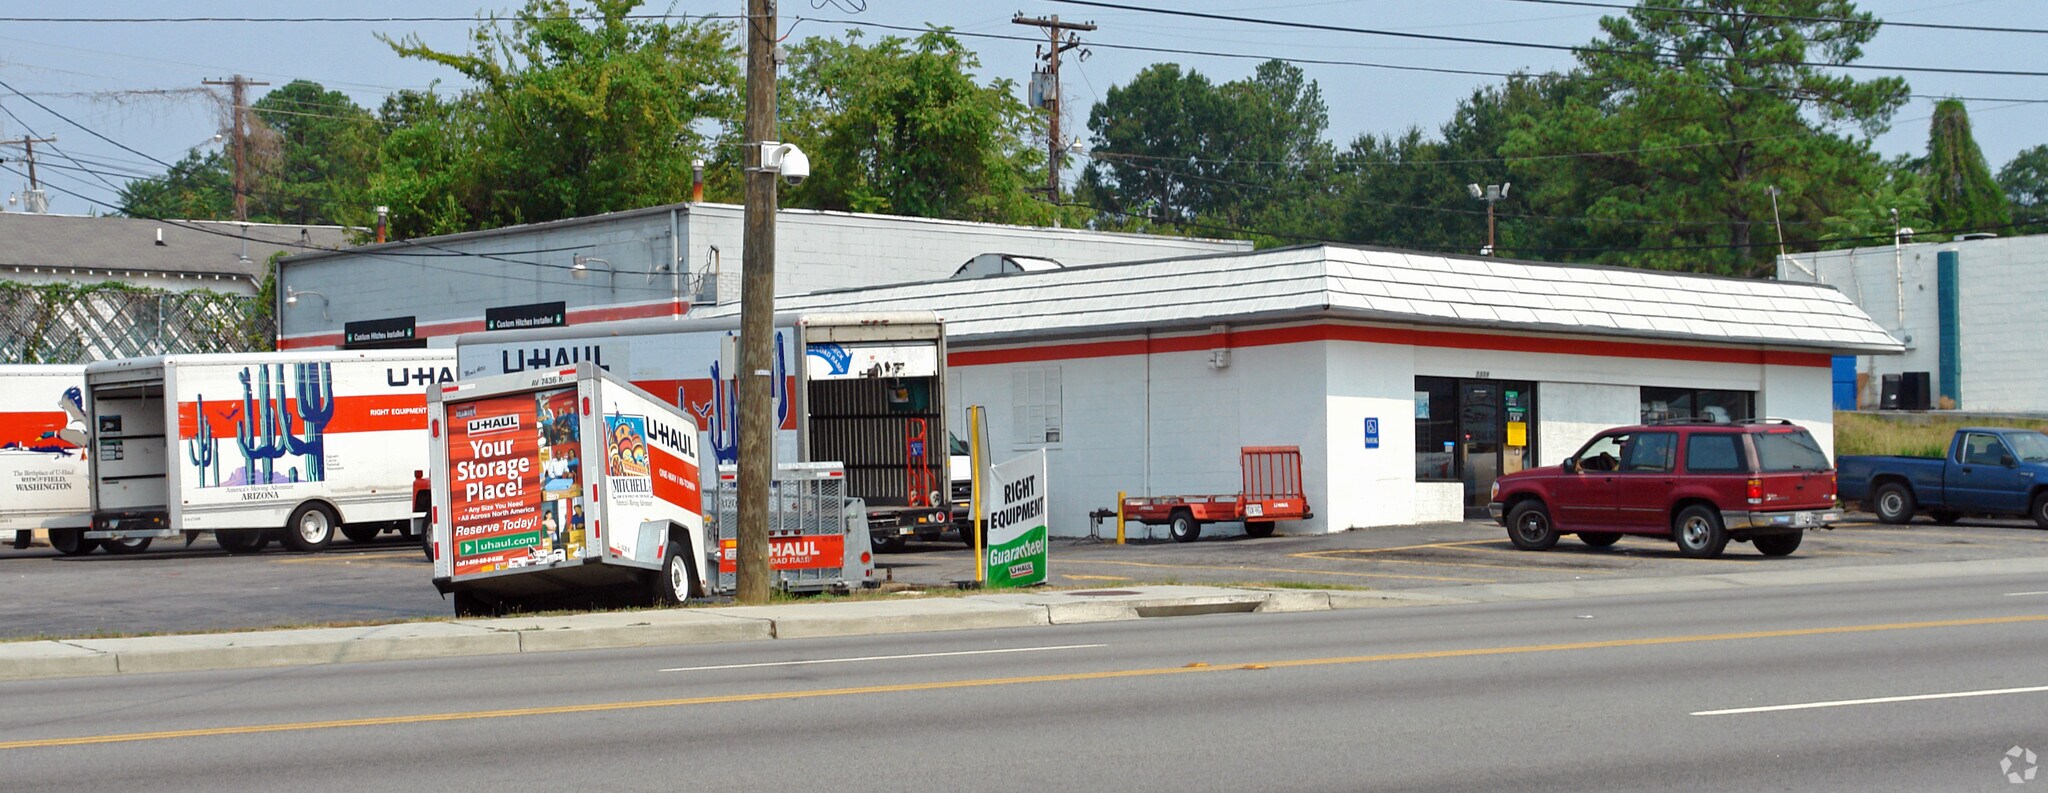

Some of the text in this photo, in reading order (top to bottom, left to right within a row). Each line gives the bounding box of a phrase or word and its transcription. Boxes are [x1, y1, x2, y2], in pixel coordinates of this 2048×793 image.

[496, 316, 553, 328] Custom Hitches Installed
[354, 330, 405, 341] Custom Hitches Installed
[387, 366, 456, 387] U-HA
[370, 406, 427, 416] RIGHT EQUIPMENT
[469, 416, 518, 431] U-HAUL
[646, 415, 695, 459] U-HAUL
[469, 439, 514, 459] Your
[457, 456, 530, 481] Storage
[15, 482, 72, 491] WASHINGTON
[466, 476, 523, 502] Place!
[612, 478, 649, 493] MITCHELL
[1004, 474, 1035, 505] RIGHT
[241, 491, 280, 501] ARIZONA
[468, 500, 524, 514] Any Size You Need
[469, 512, 491, 520] Across
[492, 509, 509, 517] North
[510, 506, 535, 515] America
[990, 496, 1044, 530] EQUIPMENT
[455, 516, 538, 537] Reserve Today!
[480, 535, 536, 551] uhaul.com
[769, 541, 820, 557] HAUL
[769, 557, 788, 565] OAD
[1010, 562, 1033, 574] U-HAUL
